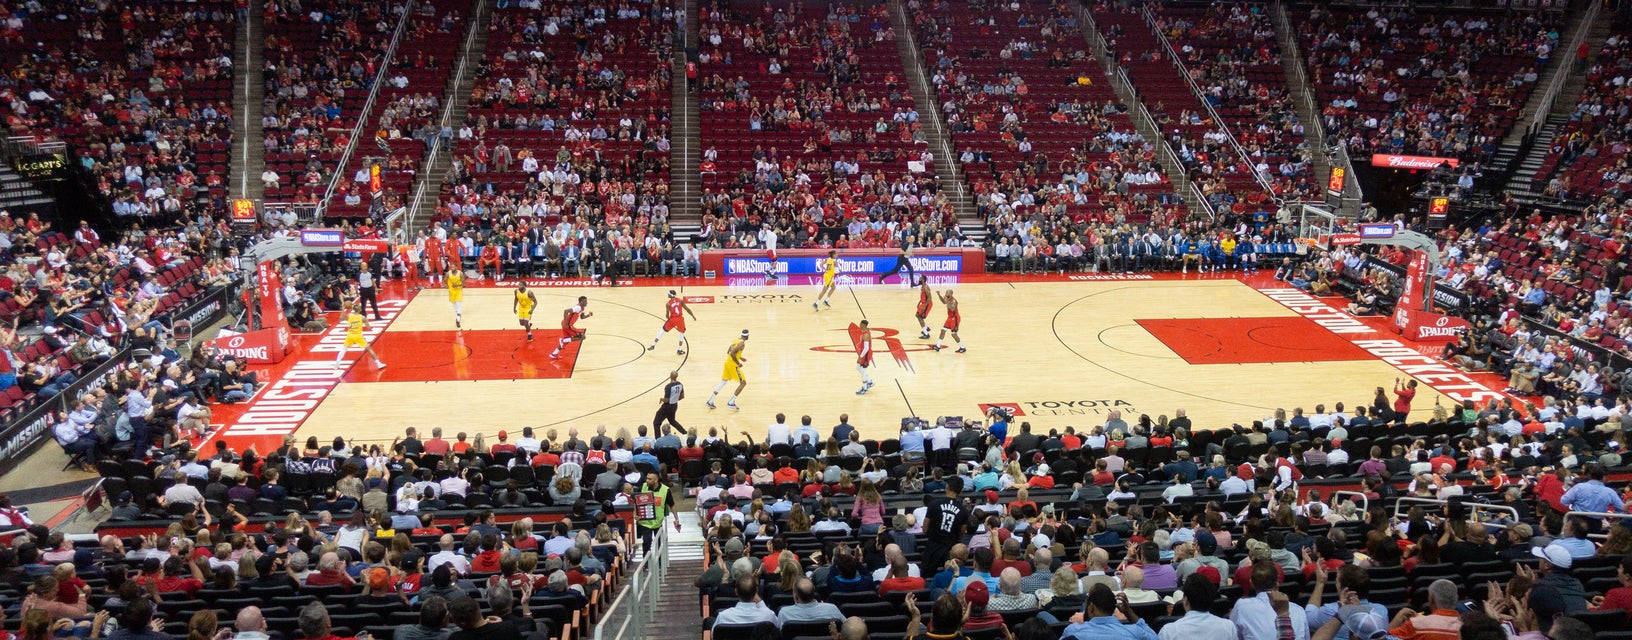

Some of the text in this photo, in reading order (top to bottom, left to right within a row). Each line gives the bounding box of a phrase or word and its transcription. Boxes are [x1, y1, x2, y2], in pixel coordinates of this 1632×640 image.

[1258, 288, 1377, 334] HOUSTON
[1433, 288, 1460, 307] ISSION
[1351, 339, 1504, 403] ROCKETS
[223, 360, 354, 436] HOUSTON
[1024, 399, 1132, 409] TOYOTA
[941, 511, 955, 533] 13
